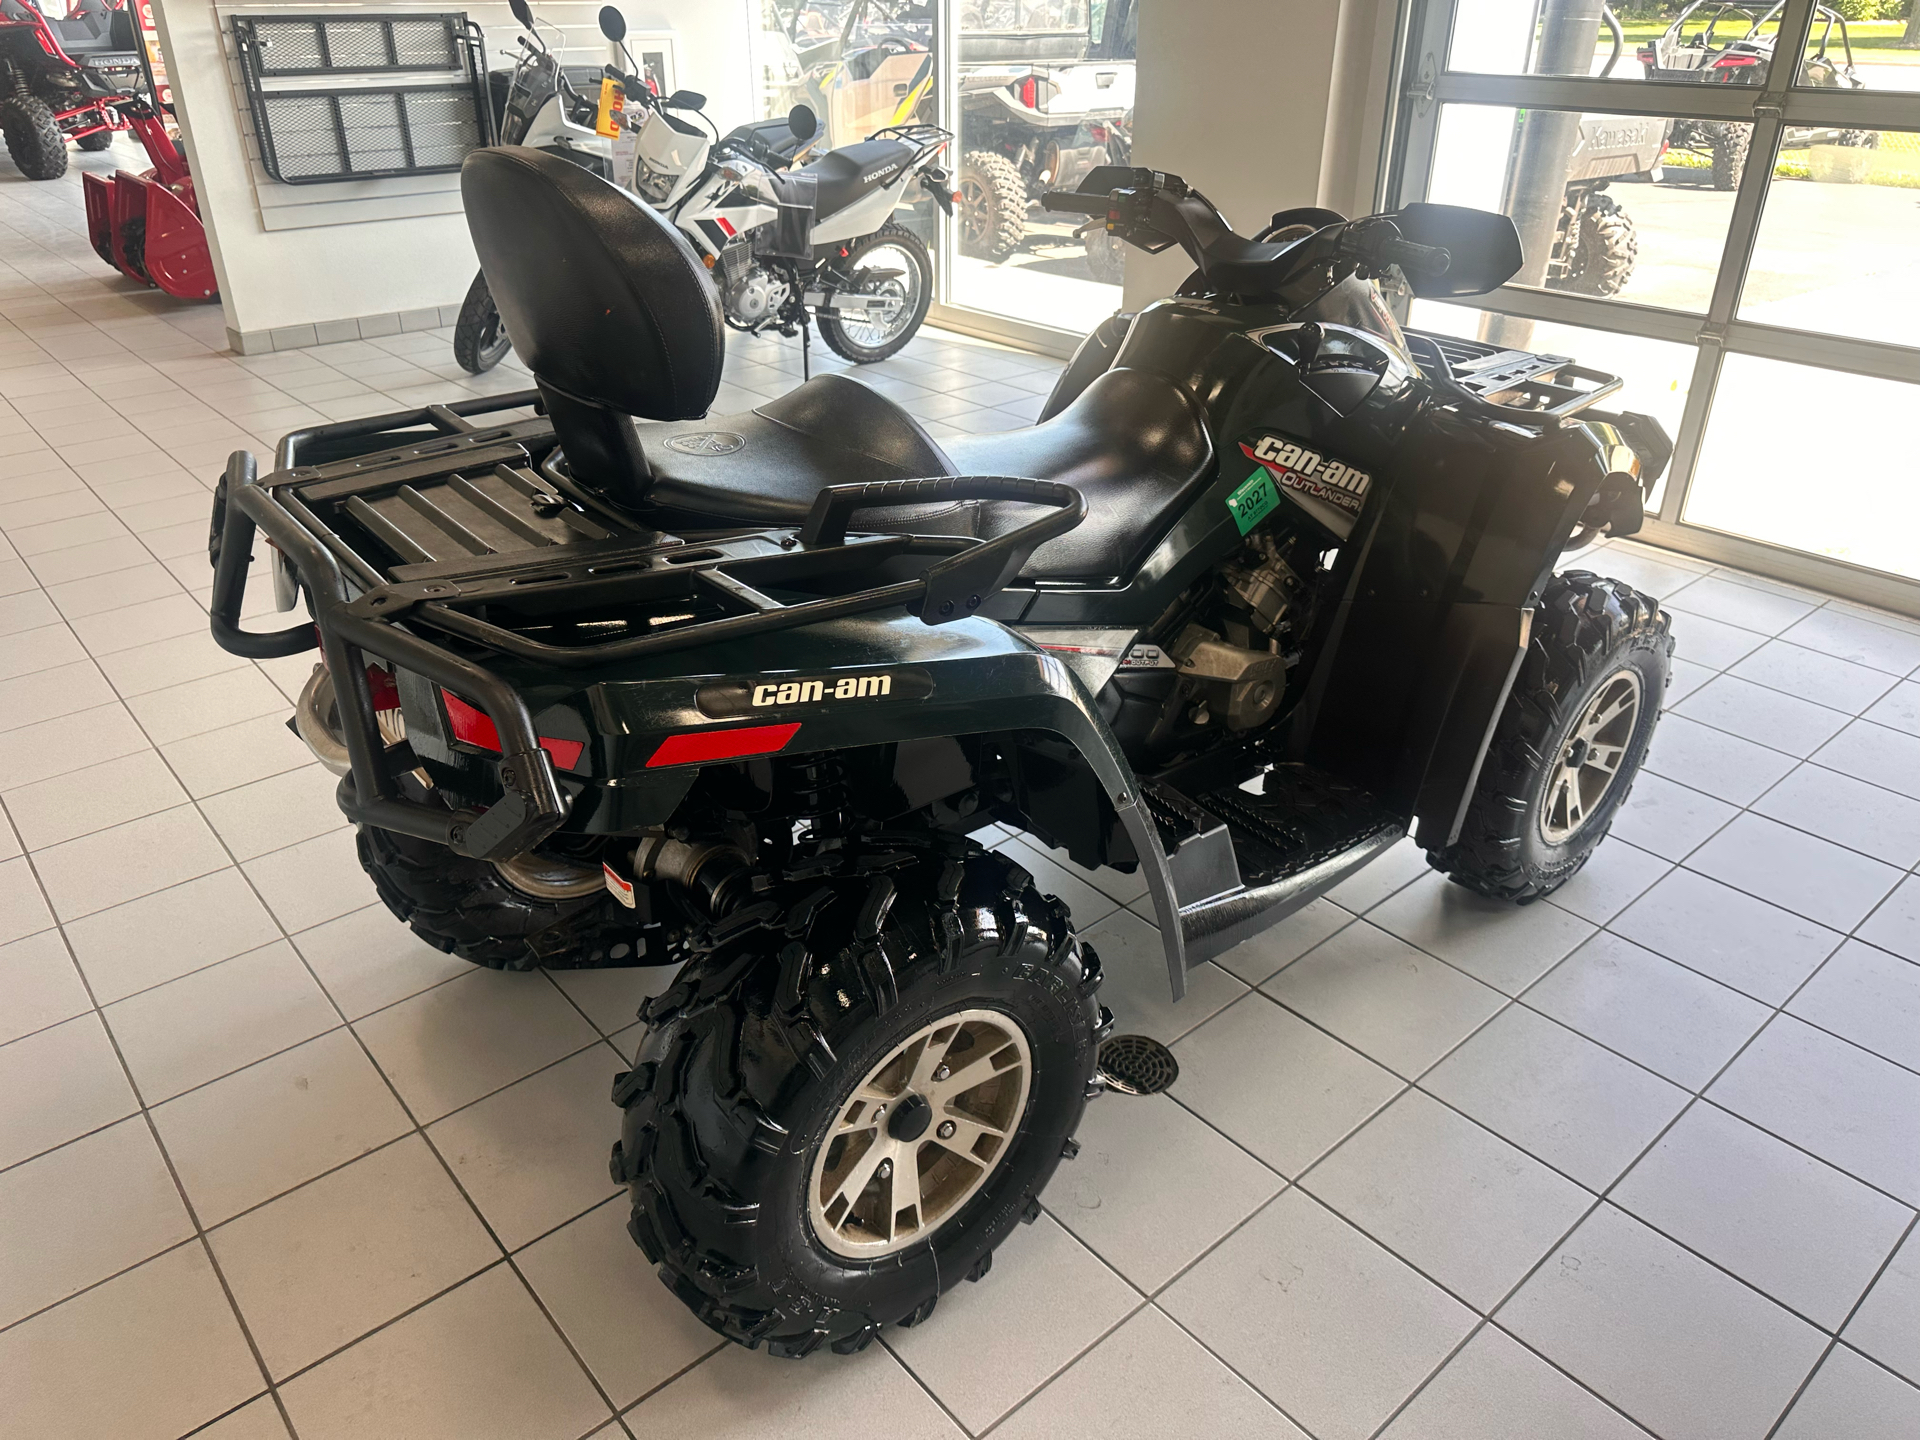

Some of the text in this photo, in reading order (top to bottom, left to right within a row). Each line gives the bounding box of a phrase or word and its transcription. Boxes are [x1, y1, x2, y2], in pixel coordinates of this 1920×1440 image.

[93, 57, 140, 66] HONDA
[610, 88, 625, 132] HOD
[1587, 122, 1650, 150] Kawasaki
[863, 163, 899, 184] HONDA
[1254, 435, 1370, 495] can-am
[1238, 482, 1267, 518] 2027
[1281, 472, 1360, 511] OUTLANDER
[752, 675, 892, 707] can-am
